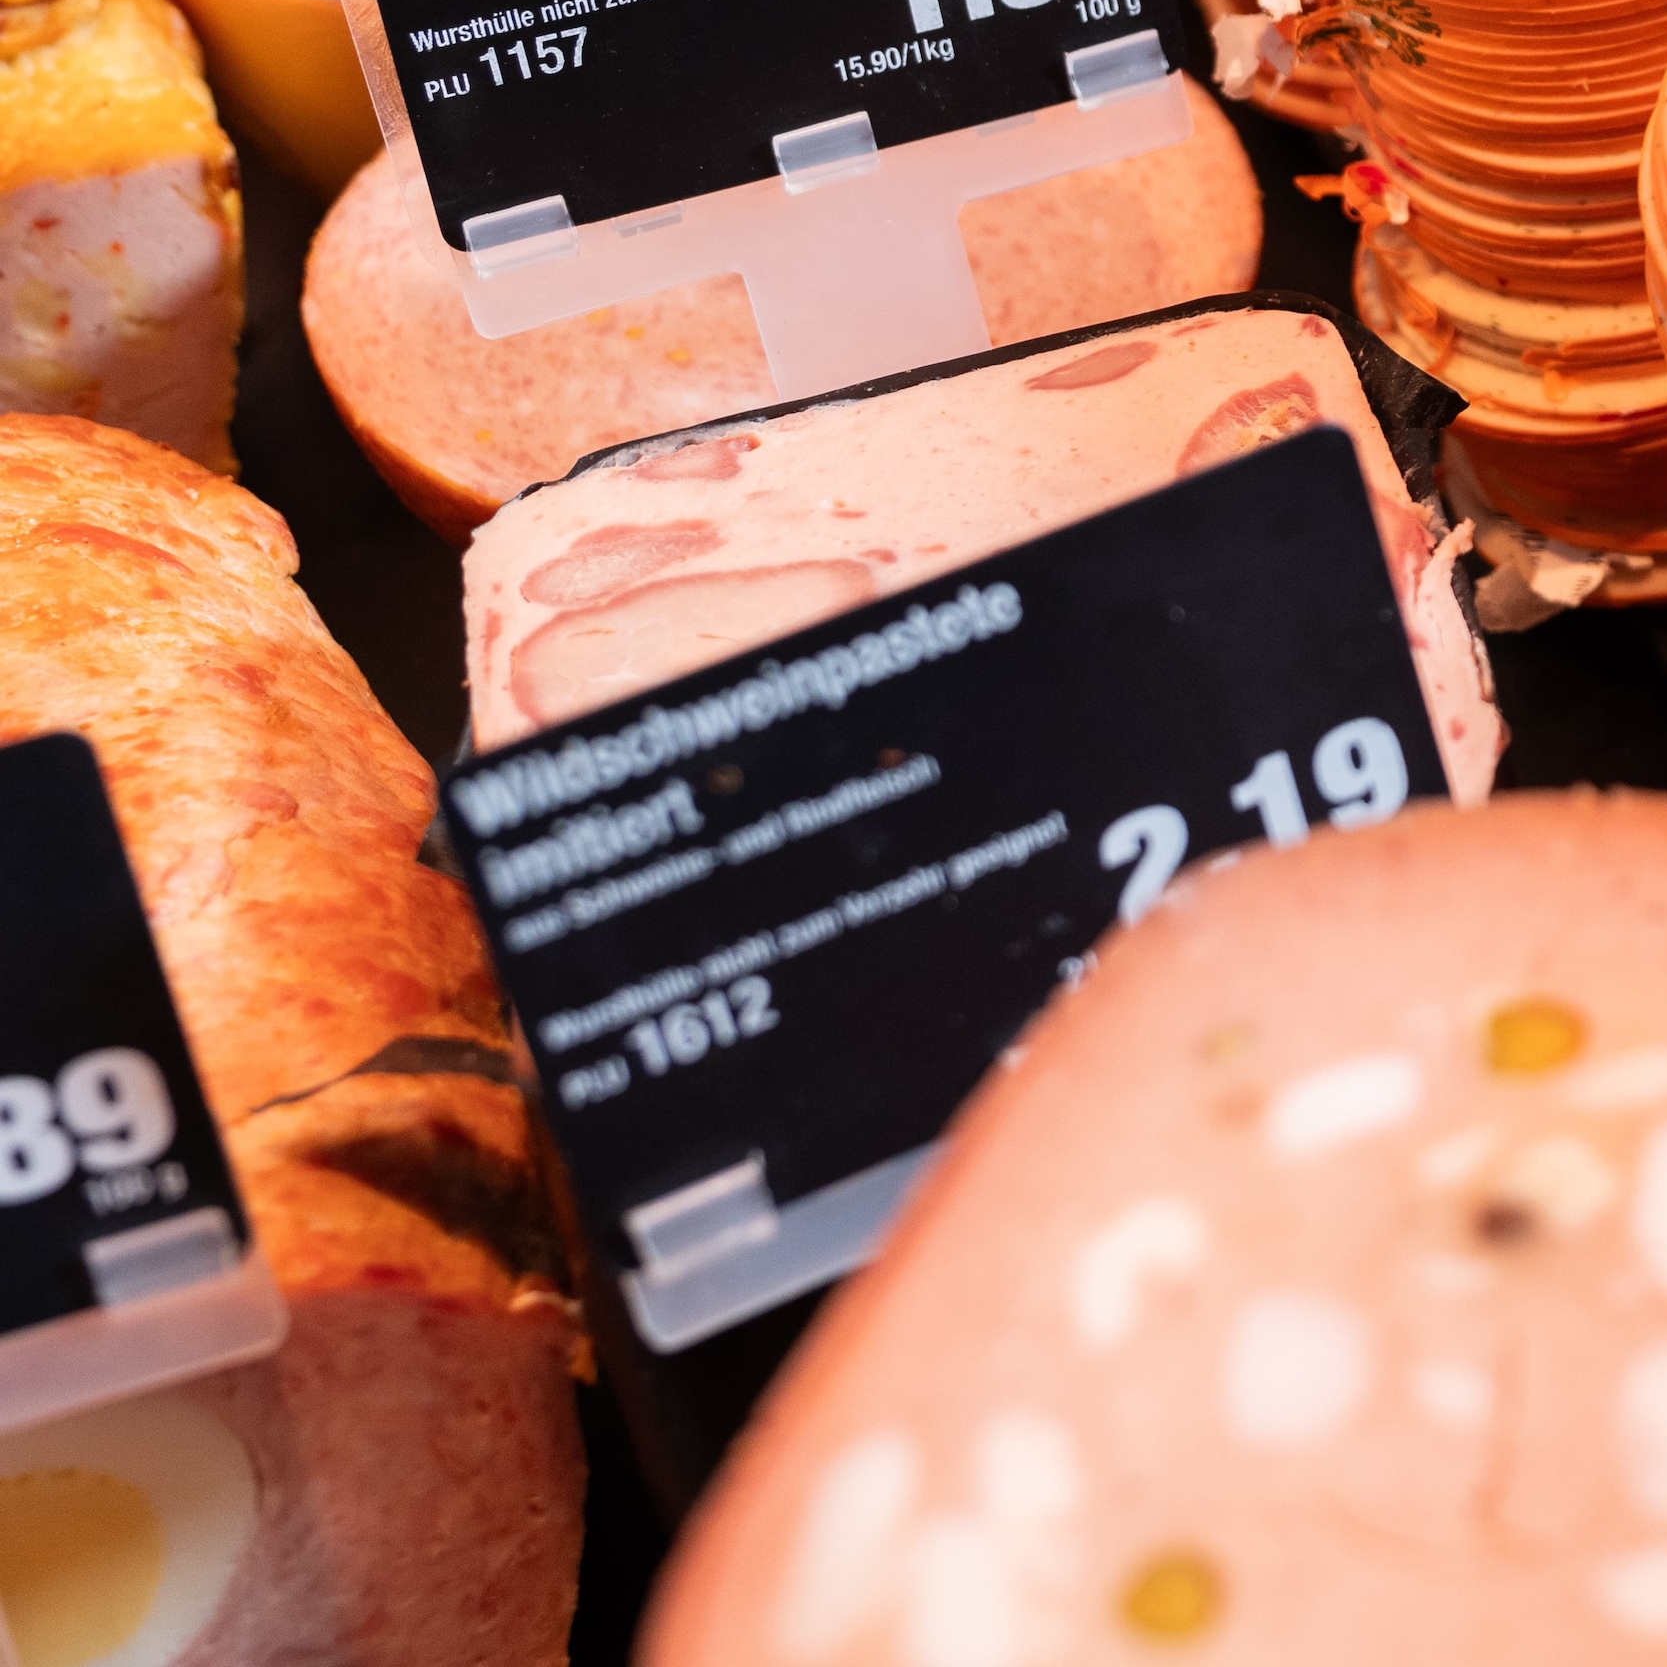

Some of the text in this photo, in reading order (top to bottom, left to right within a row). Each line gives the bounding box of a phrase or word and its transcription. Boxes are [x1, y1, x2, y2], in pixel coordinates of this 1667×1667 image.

[409, 8, 535, 53] Wursthülle
[424, 27, 589, 102] PLU 1157
[834, 37, 956, 82] 15.90/1kg
[450, 581, 1023, 835] Wildschweinpastete
[626, 975, 780, 1075] 1612
